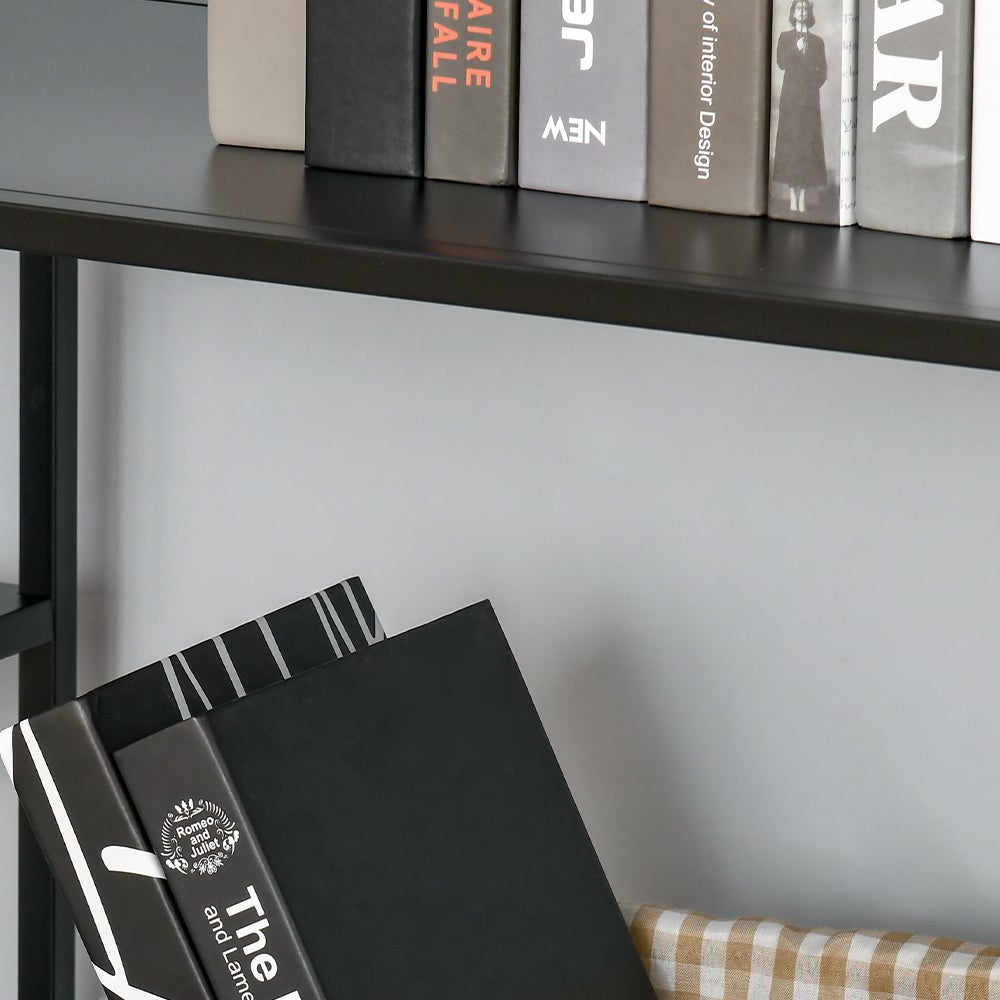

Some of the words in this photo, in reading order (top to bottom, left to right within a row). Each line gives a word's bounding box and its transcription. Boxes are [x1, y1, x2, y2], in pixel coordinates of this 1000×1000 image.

[702, 11, 718, 33] of
[432, 1, 459, 92] FALL
[700, 35, 717, 106] interior
[541, 115, 606, 146] NEW
[694, 110, 716, 180] Design
[175, 816, 215, 838] Romeo
[190, 828, 211, 845] and
[190, 837, 221, 858] Juliet
[204, 905, 233, 944] and
[226, 884, 278, 982] The
